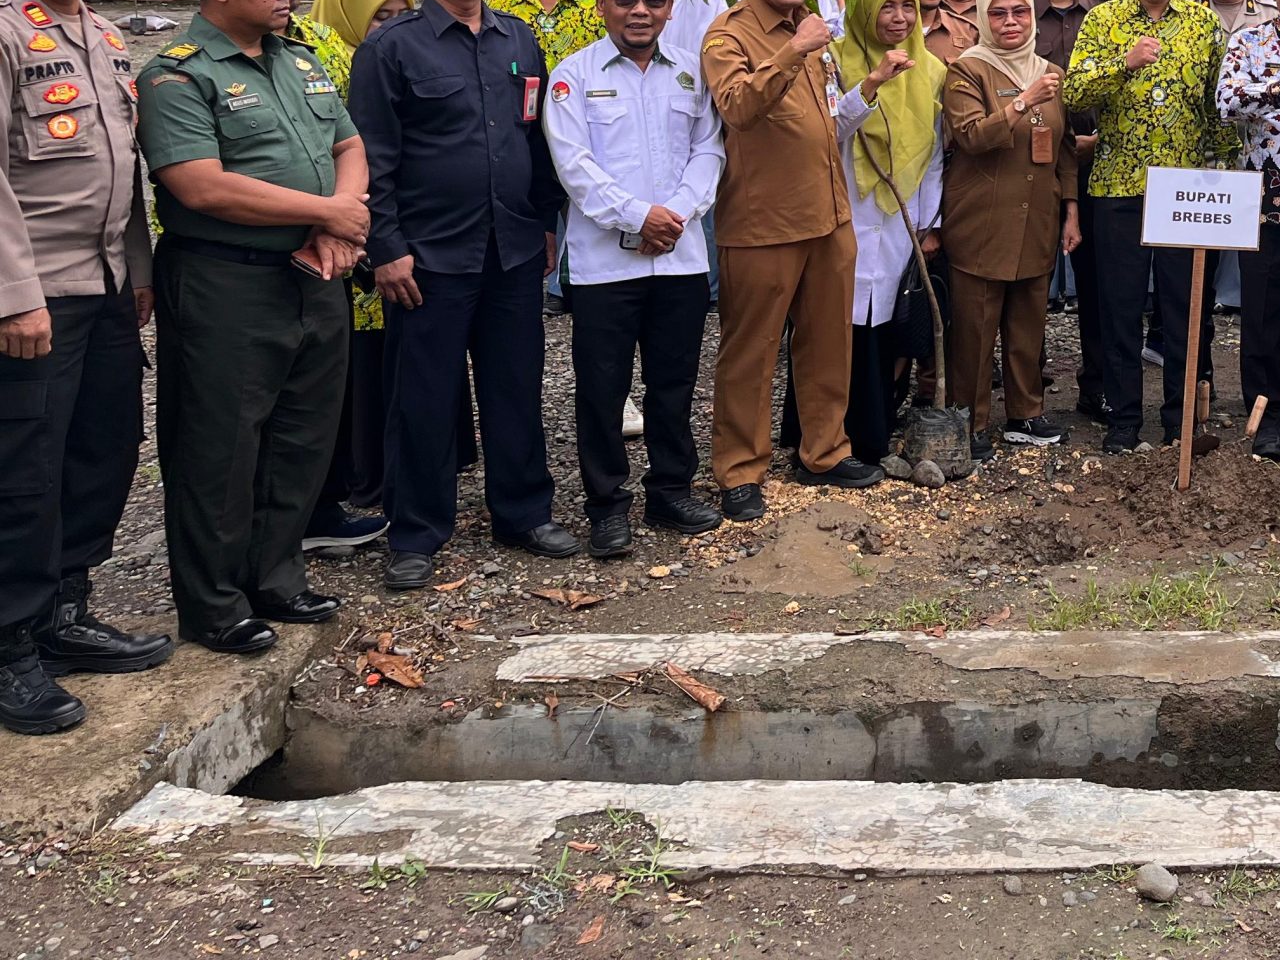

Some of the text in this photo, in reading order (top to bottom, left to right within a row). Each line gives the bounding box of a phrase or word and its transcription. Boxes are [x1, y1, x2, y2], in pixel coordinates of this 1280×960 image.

[24, 61, 75, 81] PRAPTO
[1175, 190, 1231, 205] BUPATI
[1172, 211, 1232, 225] BREBES
